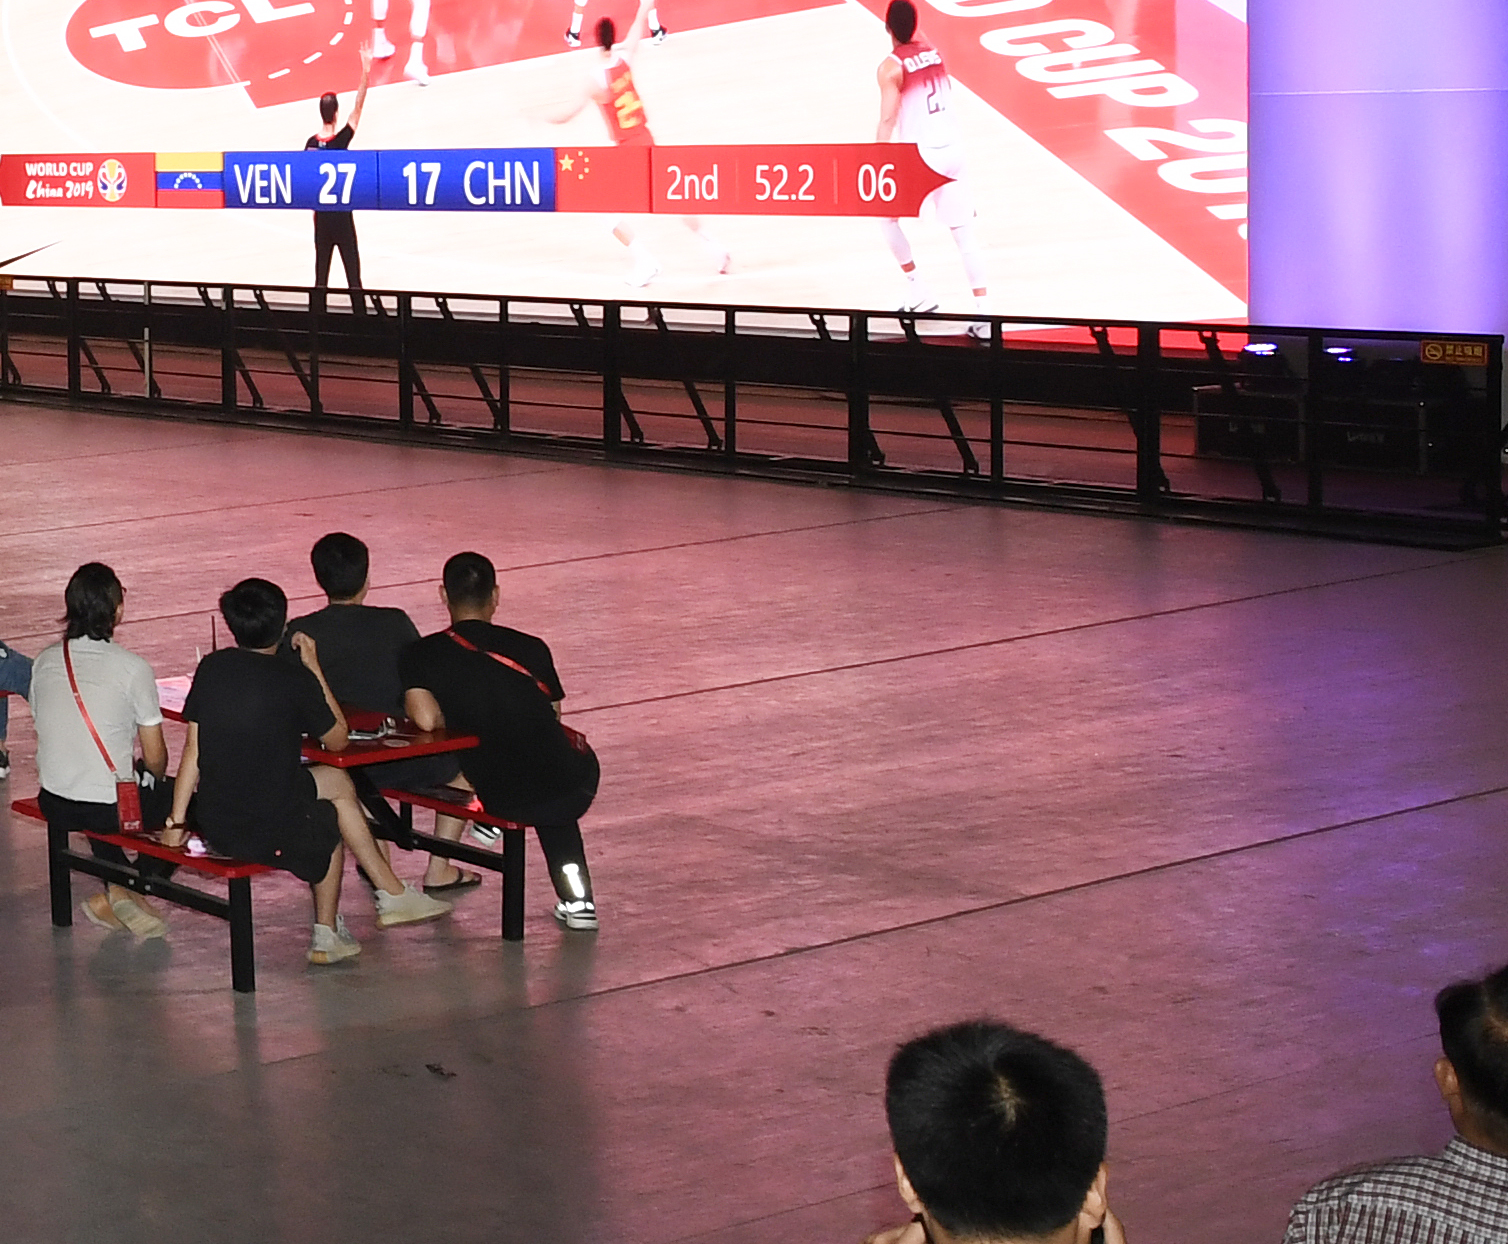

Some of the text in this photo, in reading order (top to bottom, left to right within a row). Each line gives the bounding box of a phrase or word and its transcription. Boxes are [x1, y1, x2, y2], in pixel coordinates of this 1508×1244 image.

[981, 18, 1199, 107] CUP
[1103, 118, 1248, 240] 20
[25, 161, 94, 177] WORLD CUP
[25, 179, 94, 199] China 2019
[234, 163, 292, 205] VEN
[318, 162, 357, 205] 27
[402, 162, 441, 205] 17
[463, 162, 541, 206] CHN
[666, 164, 719, 202] 2nd
[754, 164, 815, 202] 52.2
[857, 164, 896, 202] 06
